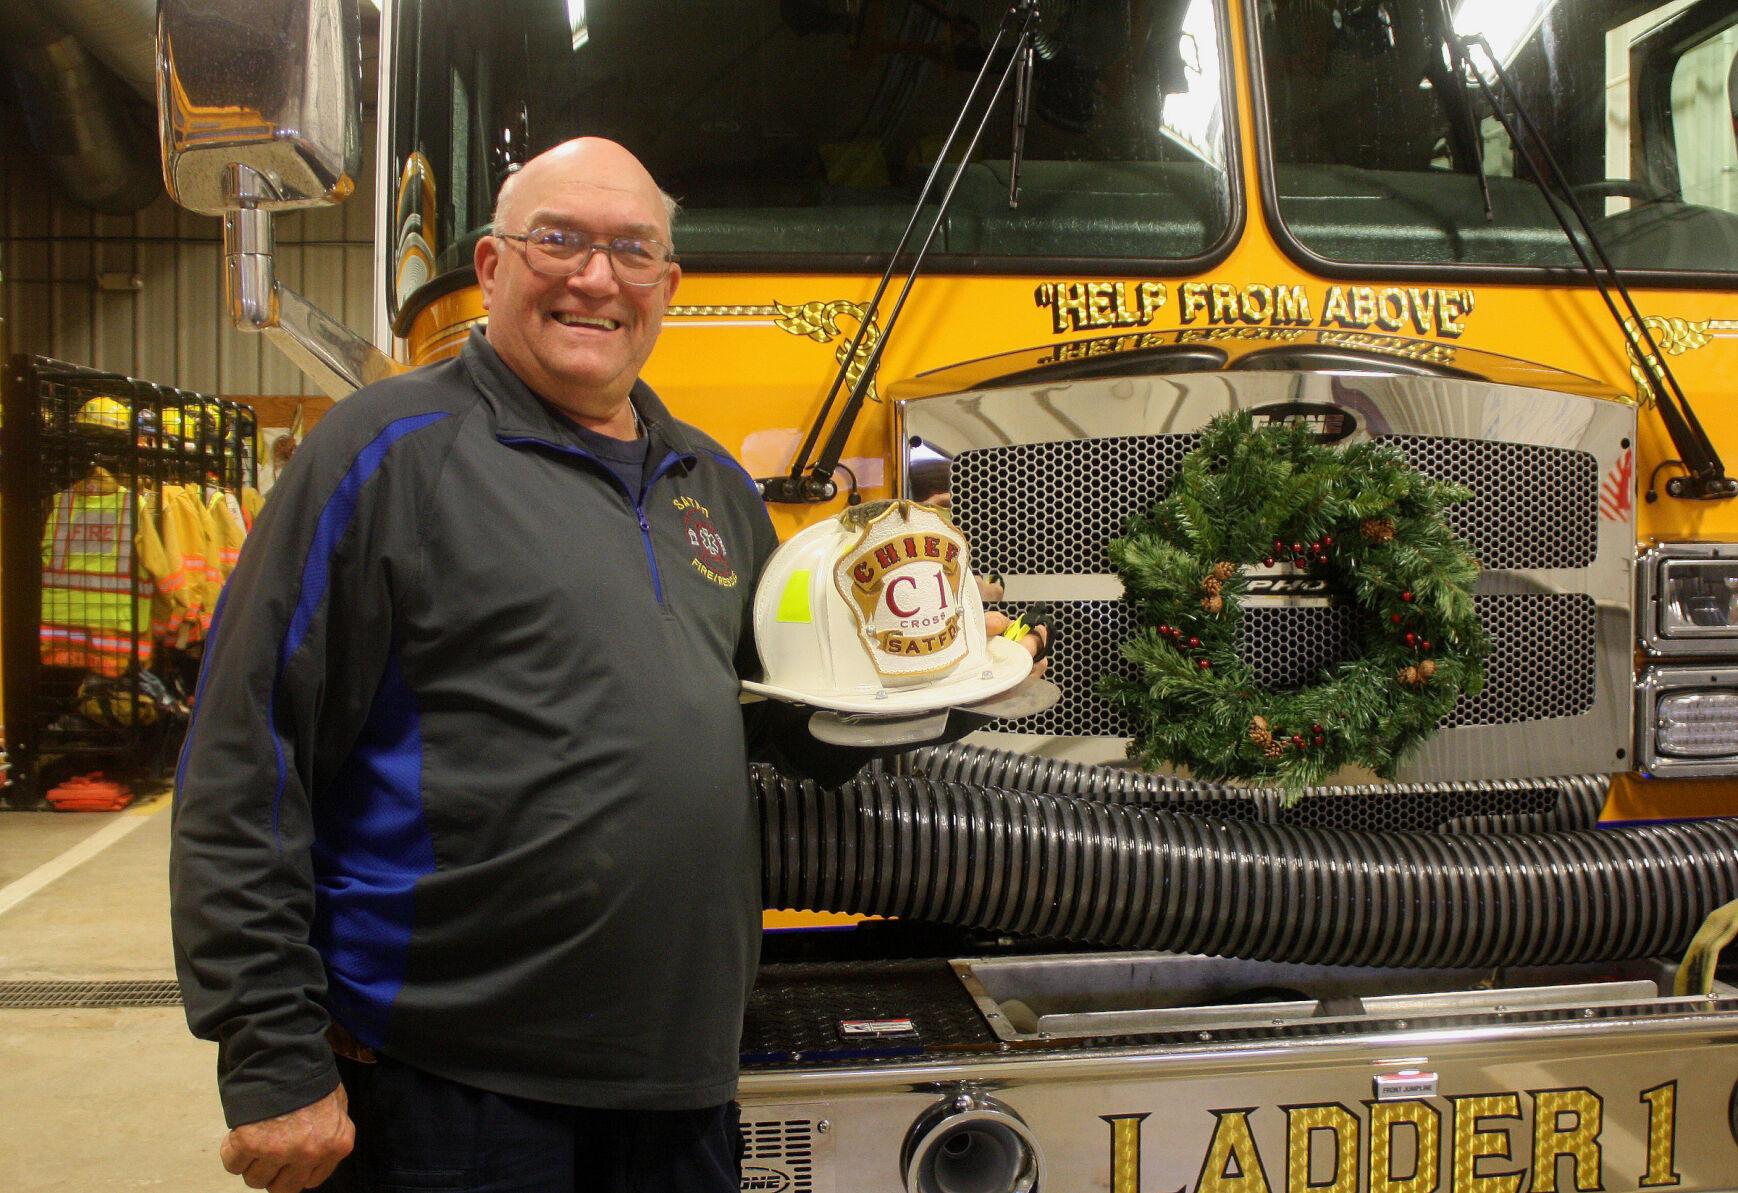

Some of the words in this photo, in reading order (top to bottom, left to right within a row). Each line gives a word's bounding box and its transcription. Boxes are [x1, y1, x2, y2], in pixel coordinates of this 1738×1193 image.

[1034, 281, 1167, 334] "HELP
[1177, 281, 1312, 325] FROM
[1320, 284, 1475, 339] ABOVE"
[71, 524, 113, 542] FRE
[854, 536, 960, 583] CHIEF
[900, 612, 946, 629] CROSS
[888, 625, 958, 654] SATFD
[1383, 1086, 1402, 1094] FRONT
[1403, 1084, 1432, 1093] JUMPLINE
[1098, 1086, 1606, 1193] LADDER
[1639, 1078, 1681, 1188] 1
